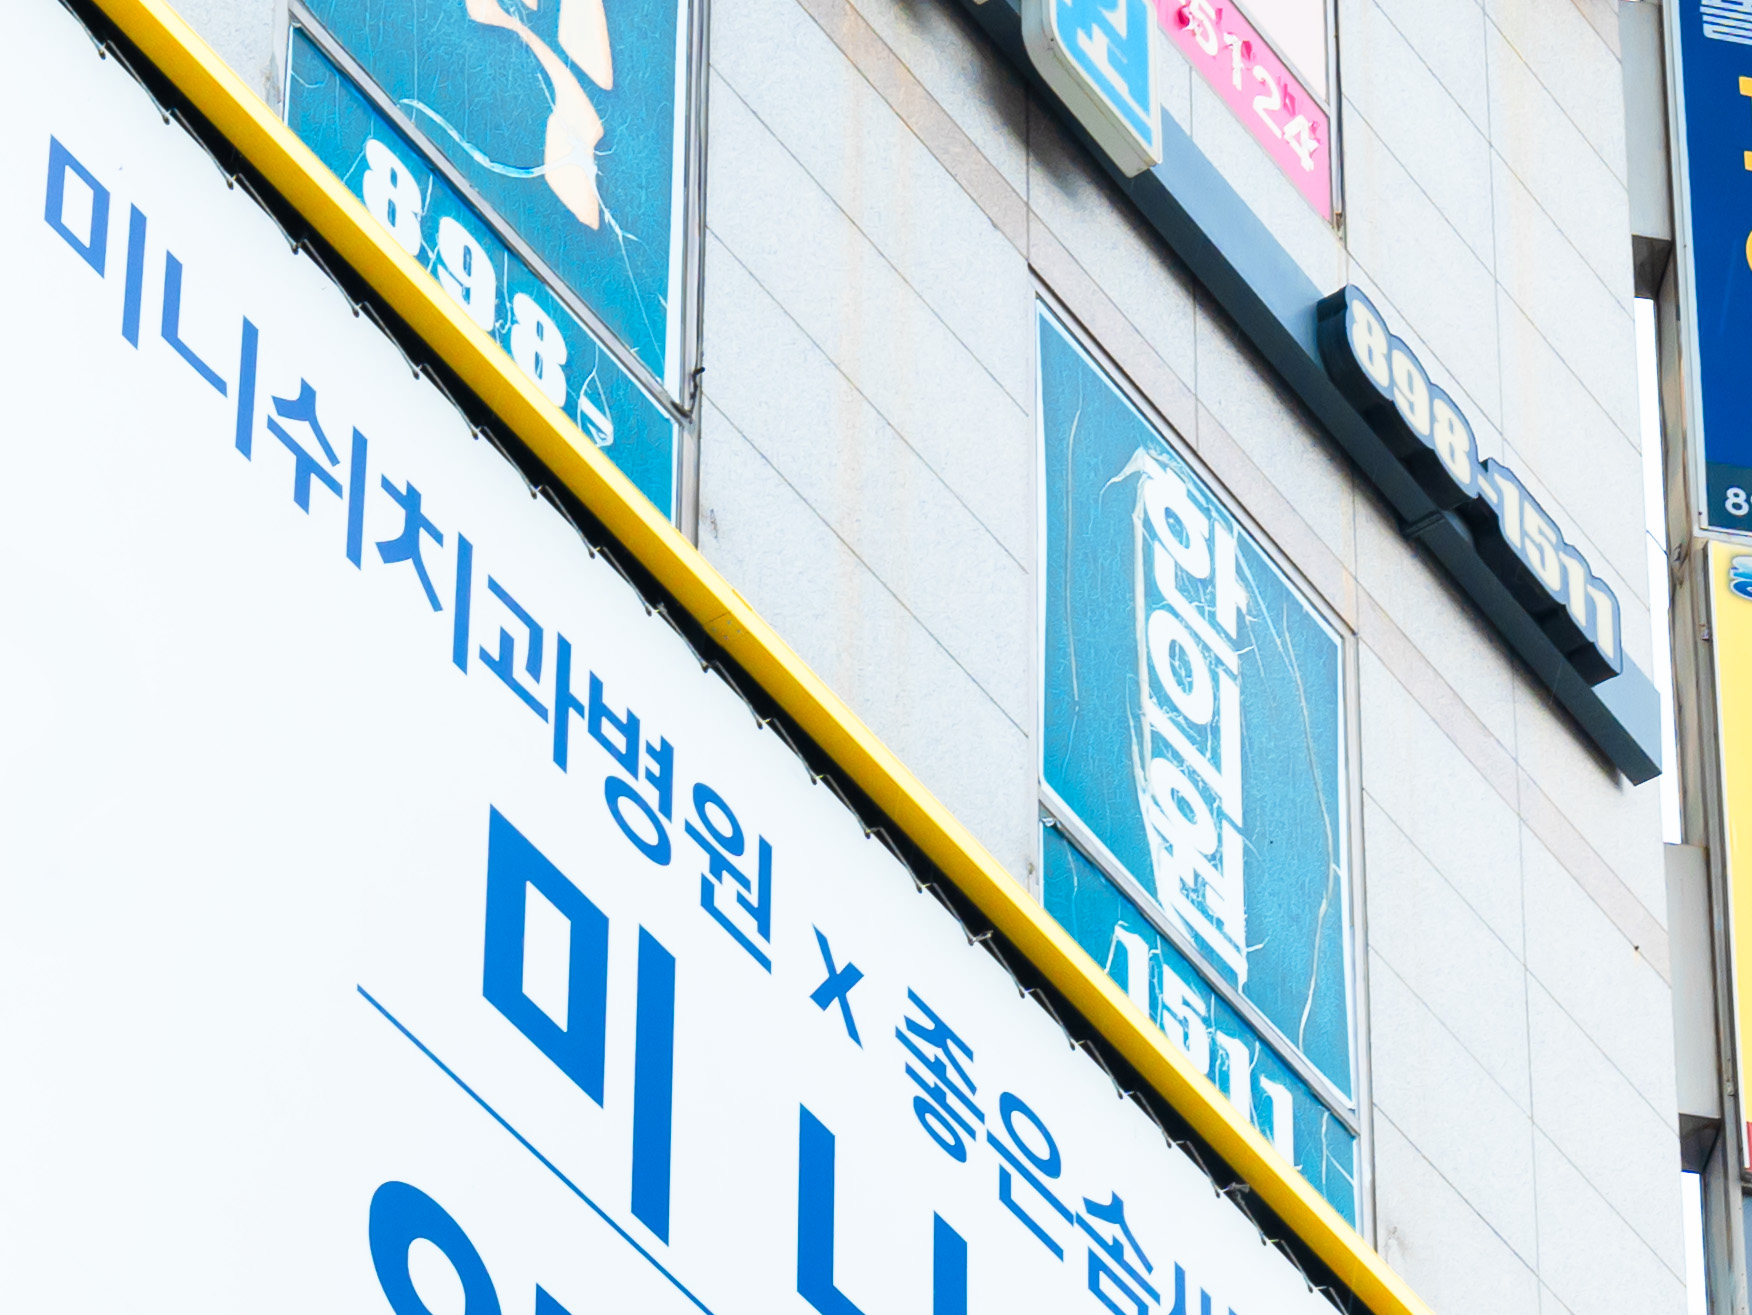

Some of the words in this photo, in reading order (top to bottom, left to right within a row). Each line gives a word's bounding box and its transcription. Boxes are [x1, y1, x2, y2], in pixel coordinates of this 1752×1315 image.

[44, 133, 772, 974] 미니쉬치과병원
[1145, 450, 1248, 992] 한의원
[1351, 298, 1615, 661] 898-1511
